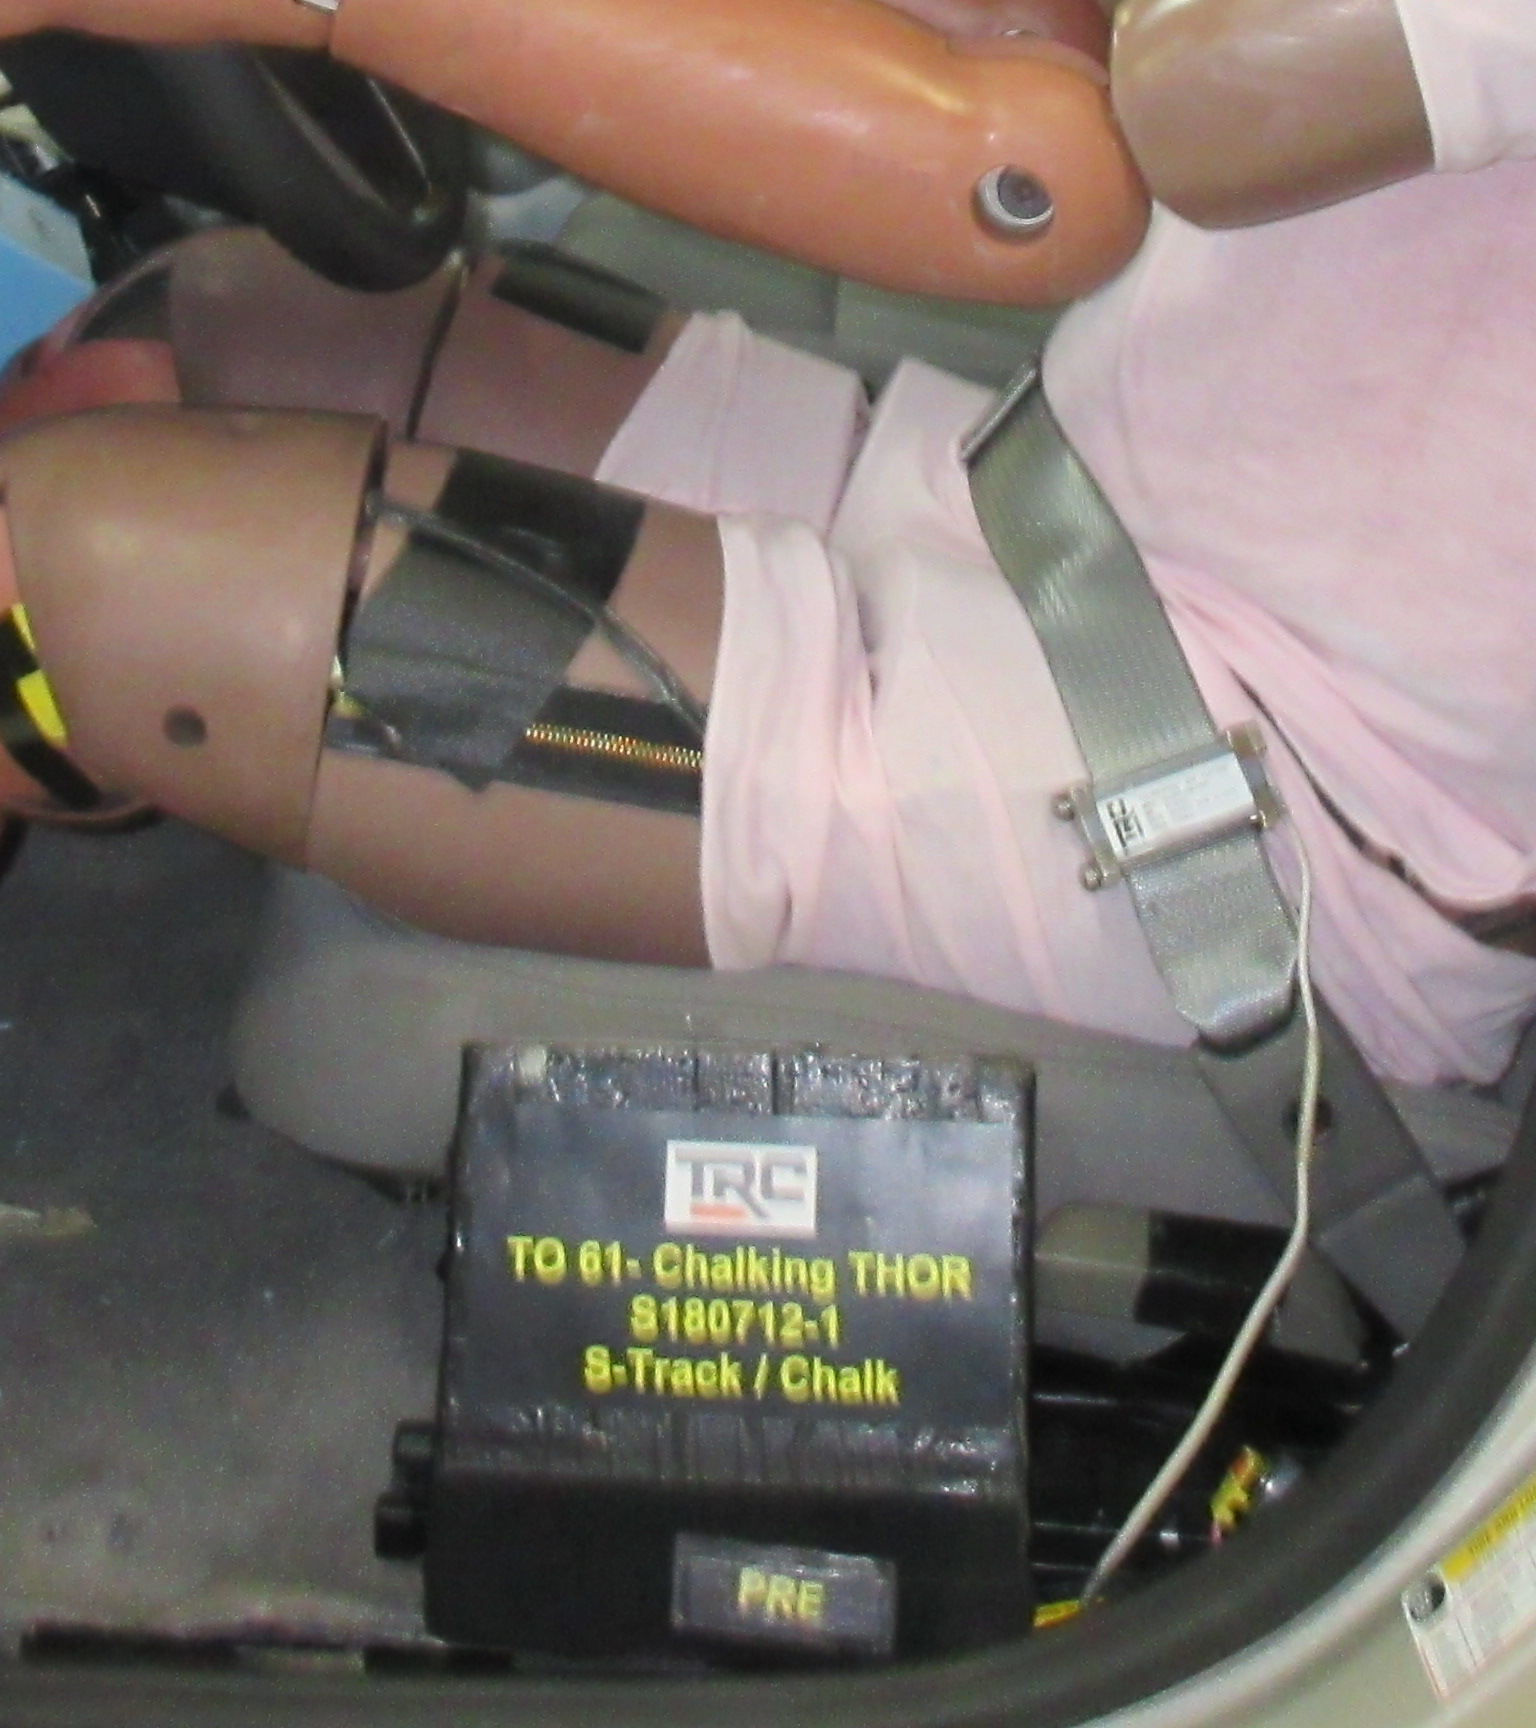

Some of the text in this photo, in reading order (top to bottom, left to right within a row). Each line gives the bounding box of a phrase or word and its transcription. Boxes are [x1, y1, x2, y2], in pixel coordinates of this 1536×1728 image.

[675, 1146, 807, 1220] TRC
[506, 1235, 567, 1285] TO
[651, 1241, 837, 1304] Chalking
[847, 1249, 972, 1303] THOR
[629, 1293, 839, 1351] S180712-1
[583, 1343, 744, 1400] S-Track
[779, 1354, 901, 1406] Chalk
[736, 1567, 826, 1625] PRE
